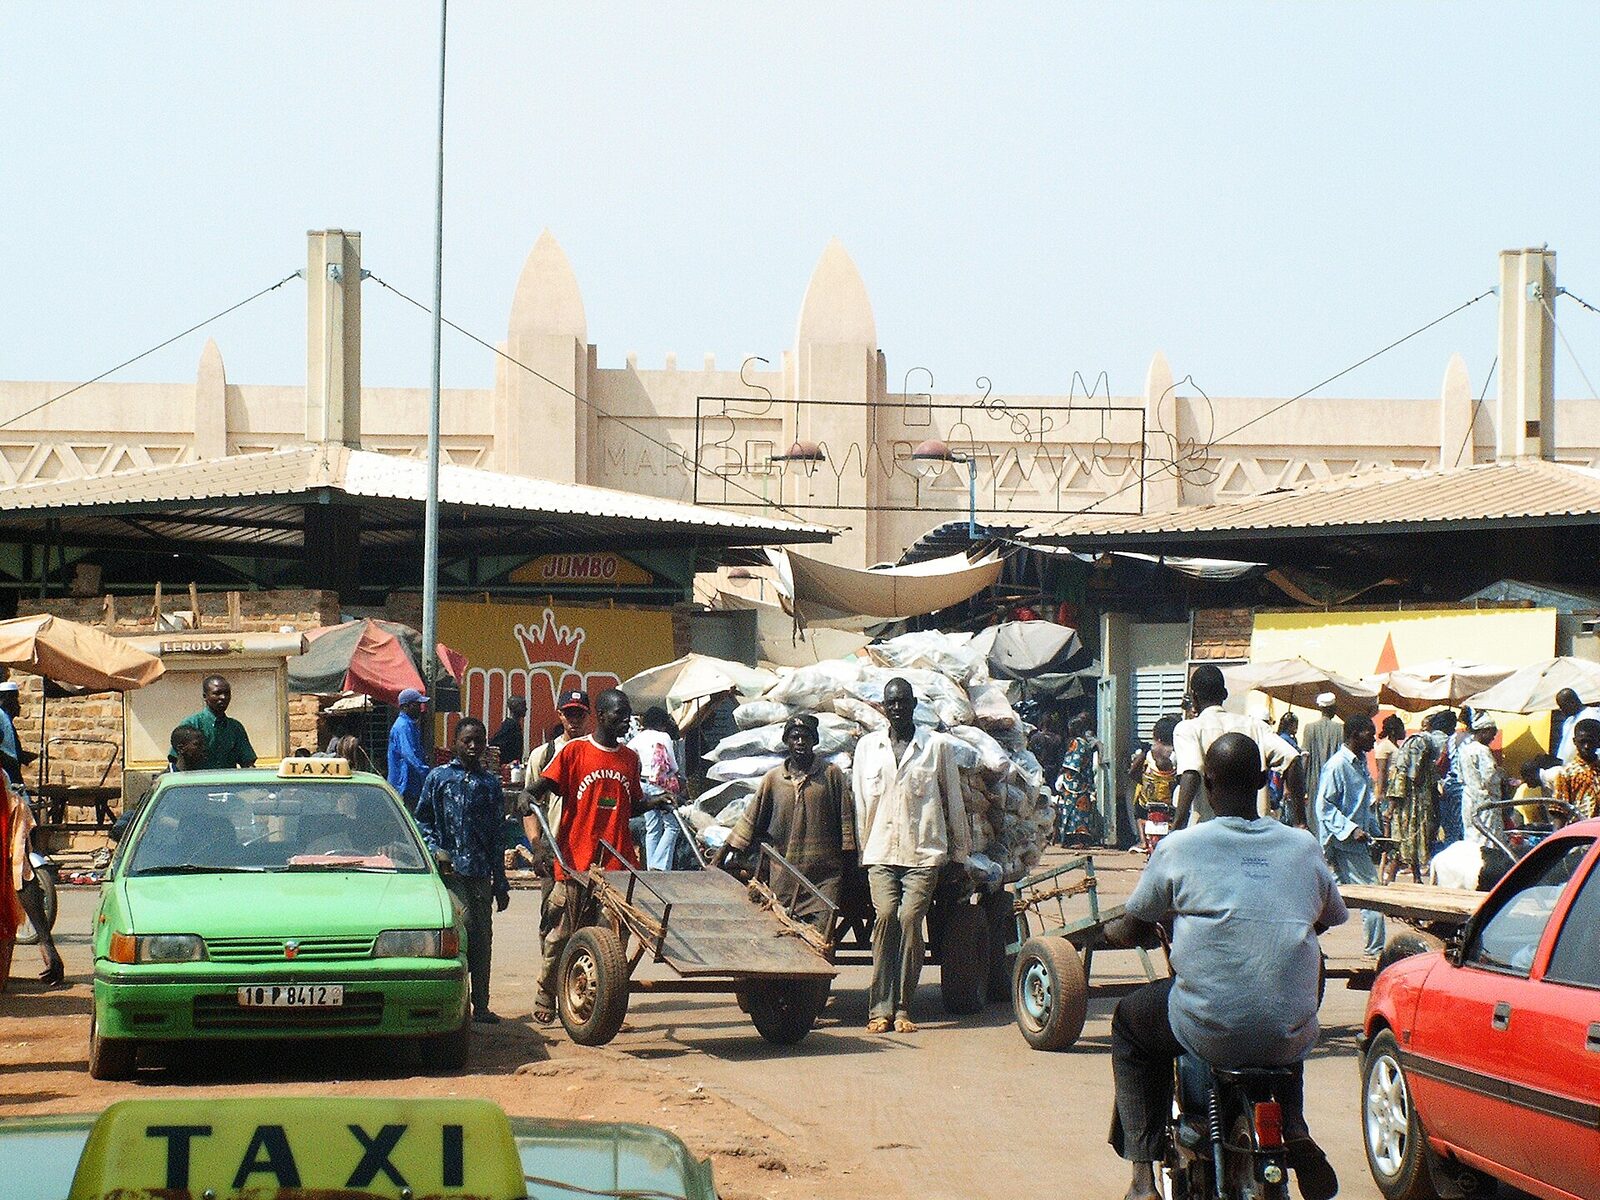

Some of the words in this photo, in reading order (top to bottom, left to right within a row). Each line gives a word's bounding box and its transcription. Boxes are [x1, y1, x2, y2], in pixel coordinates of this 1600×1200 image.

[542, 556, 617, 579] JUMBO
[164, 642, 223, 652] LEROUX
[290, 763, 340, 775] TAXI
[287, 986, 327, 1005] 8412
[145, 1124, 465, 1190] TAXI
